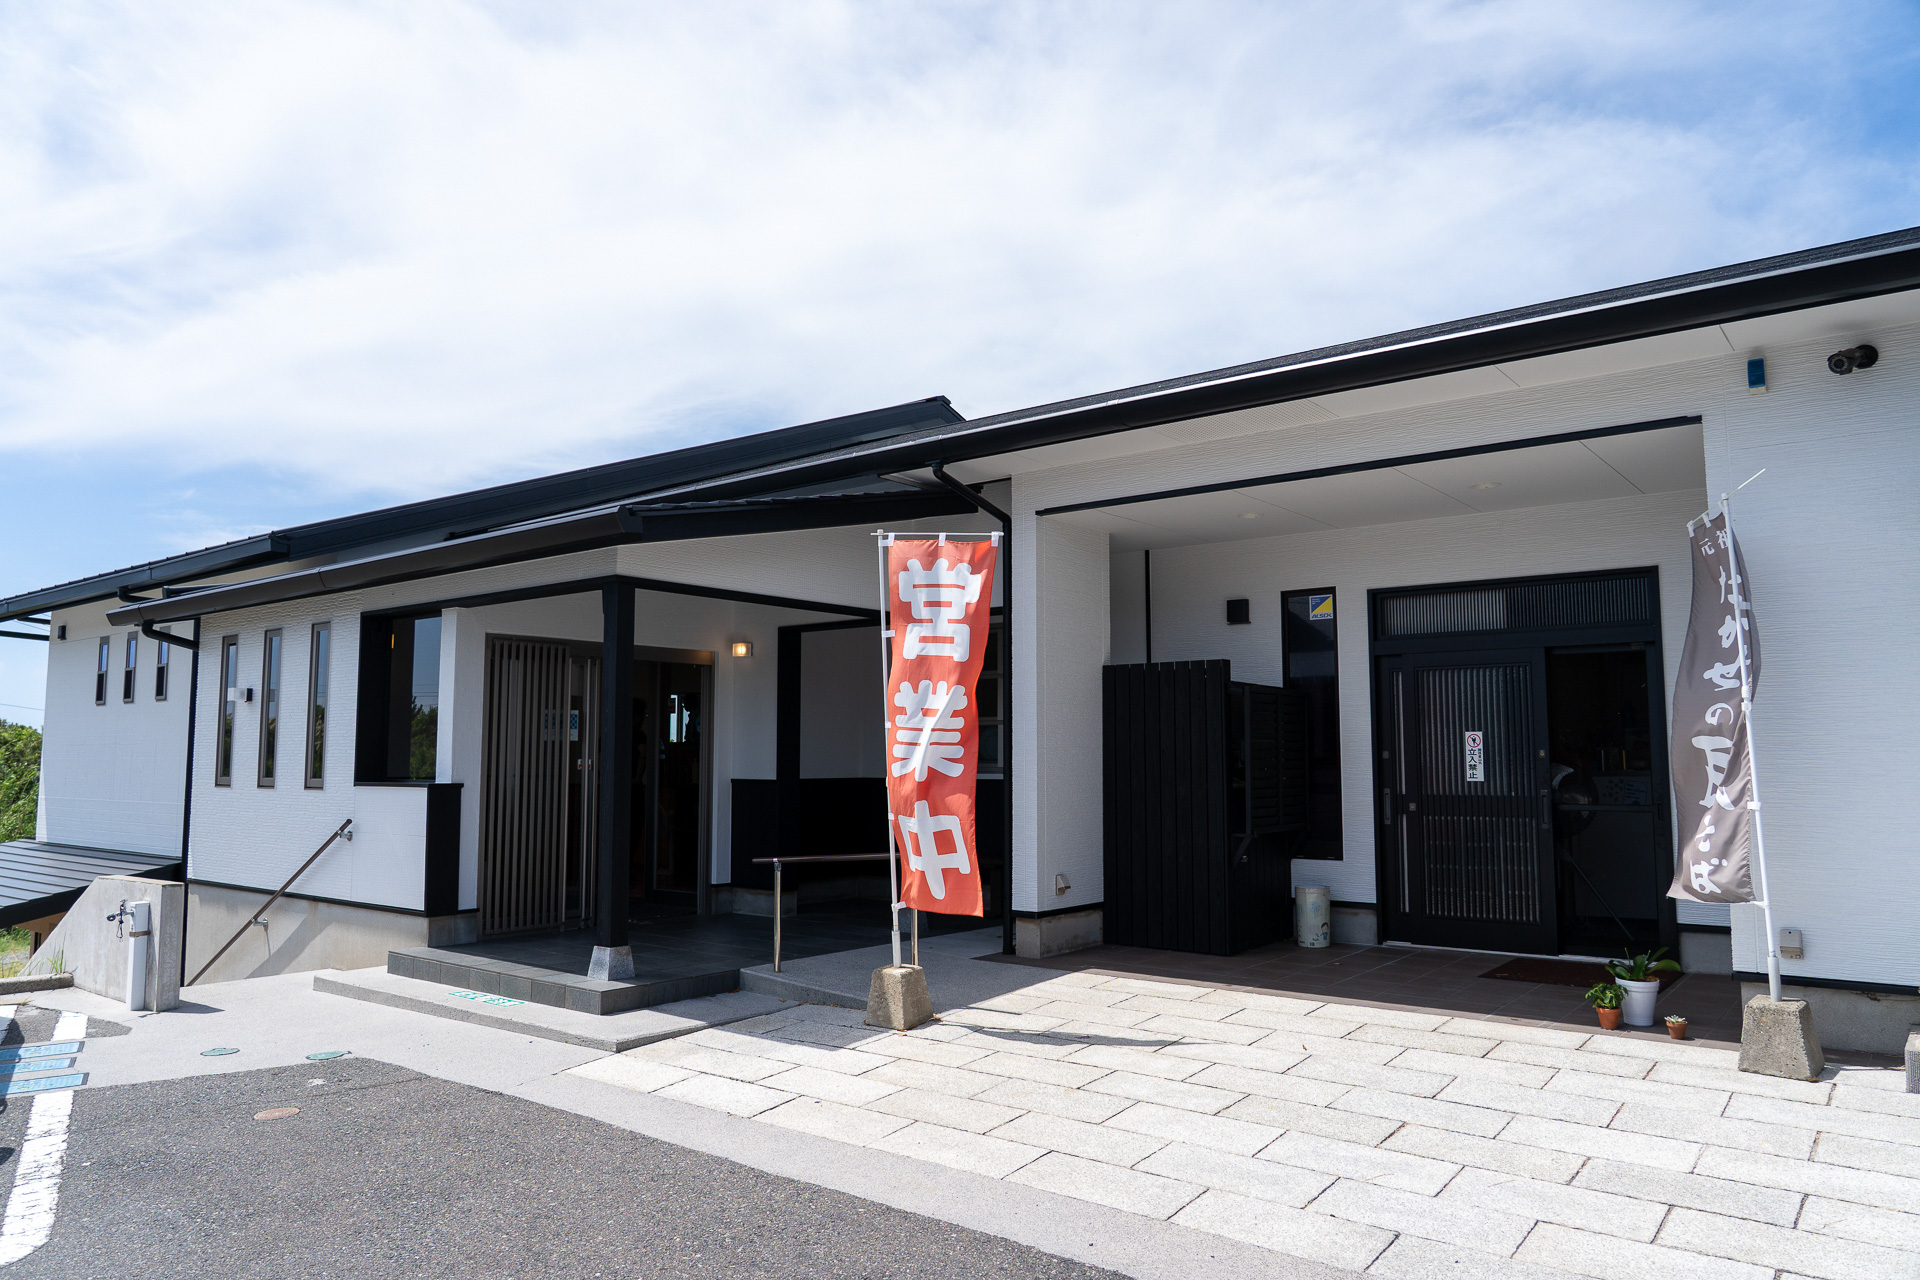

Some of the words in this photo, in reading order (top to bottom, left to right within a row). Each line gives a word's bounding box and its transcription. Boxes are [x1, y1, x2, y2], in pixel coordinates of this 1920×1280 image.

[1699, 528, 1730, 557] 元祖
[891, 558, 982, 900] 営業中
[1467, 748, 1478, 779] 立入禁止
